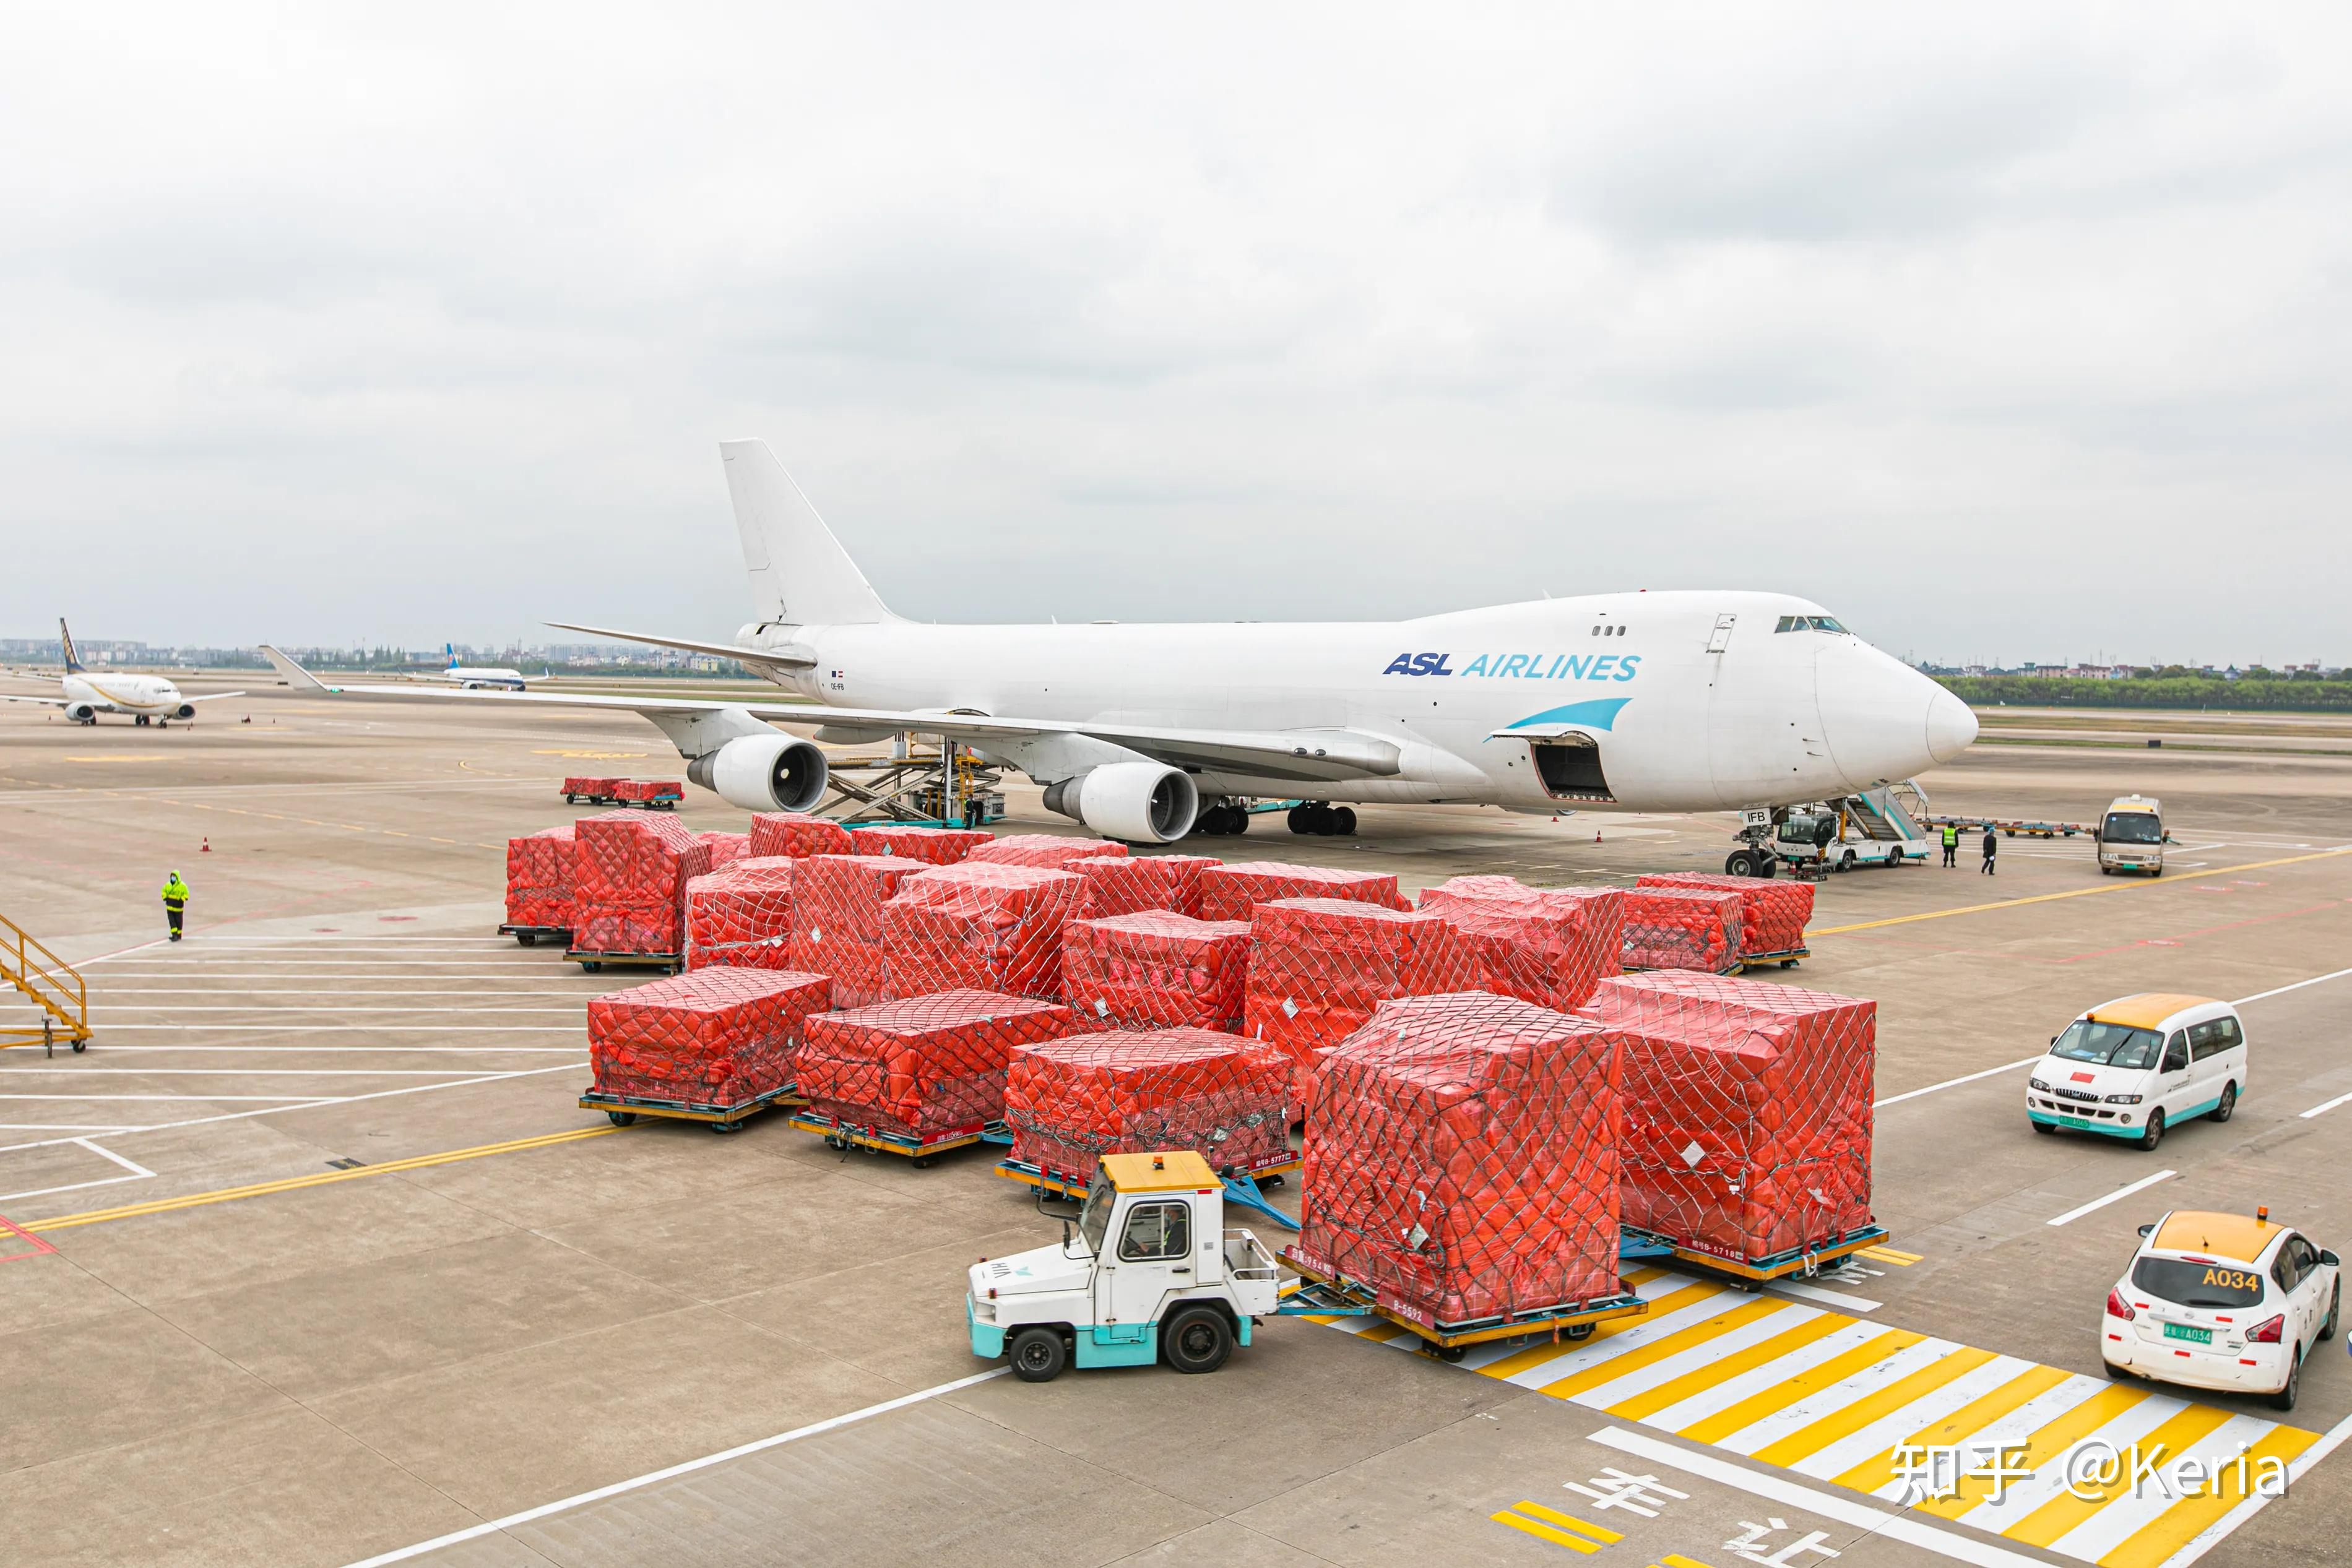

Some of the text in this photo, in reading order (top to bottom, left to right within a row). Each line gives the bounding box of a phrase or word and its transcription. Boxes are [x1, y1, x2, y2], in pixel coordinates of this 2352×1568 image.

[1382, 653, 1642, 682] ASL AIRLINES
[1747, 812, 1765, 822] IFB
[2203, 1269, 2259, 1292] A034
[1394, 1299, 1422, 1322] B-5592
[2186, 1329, 2210, 1342] A034
